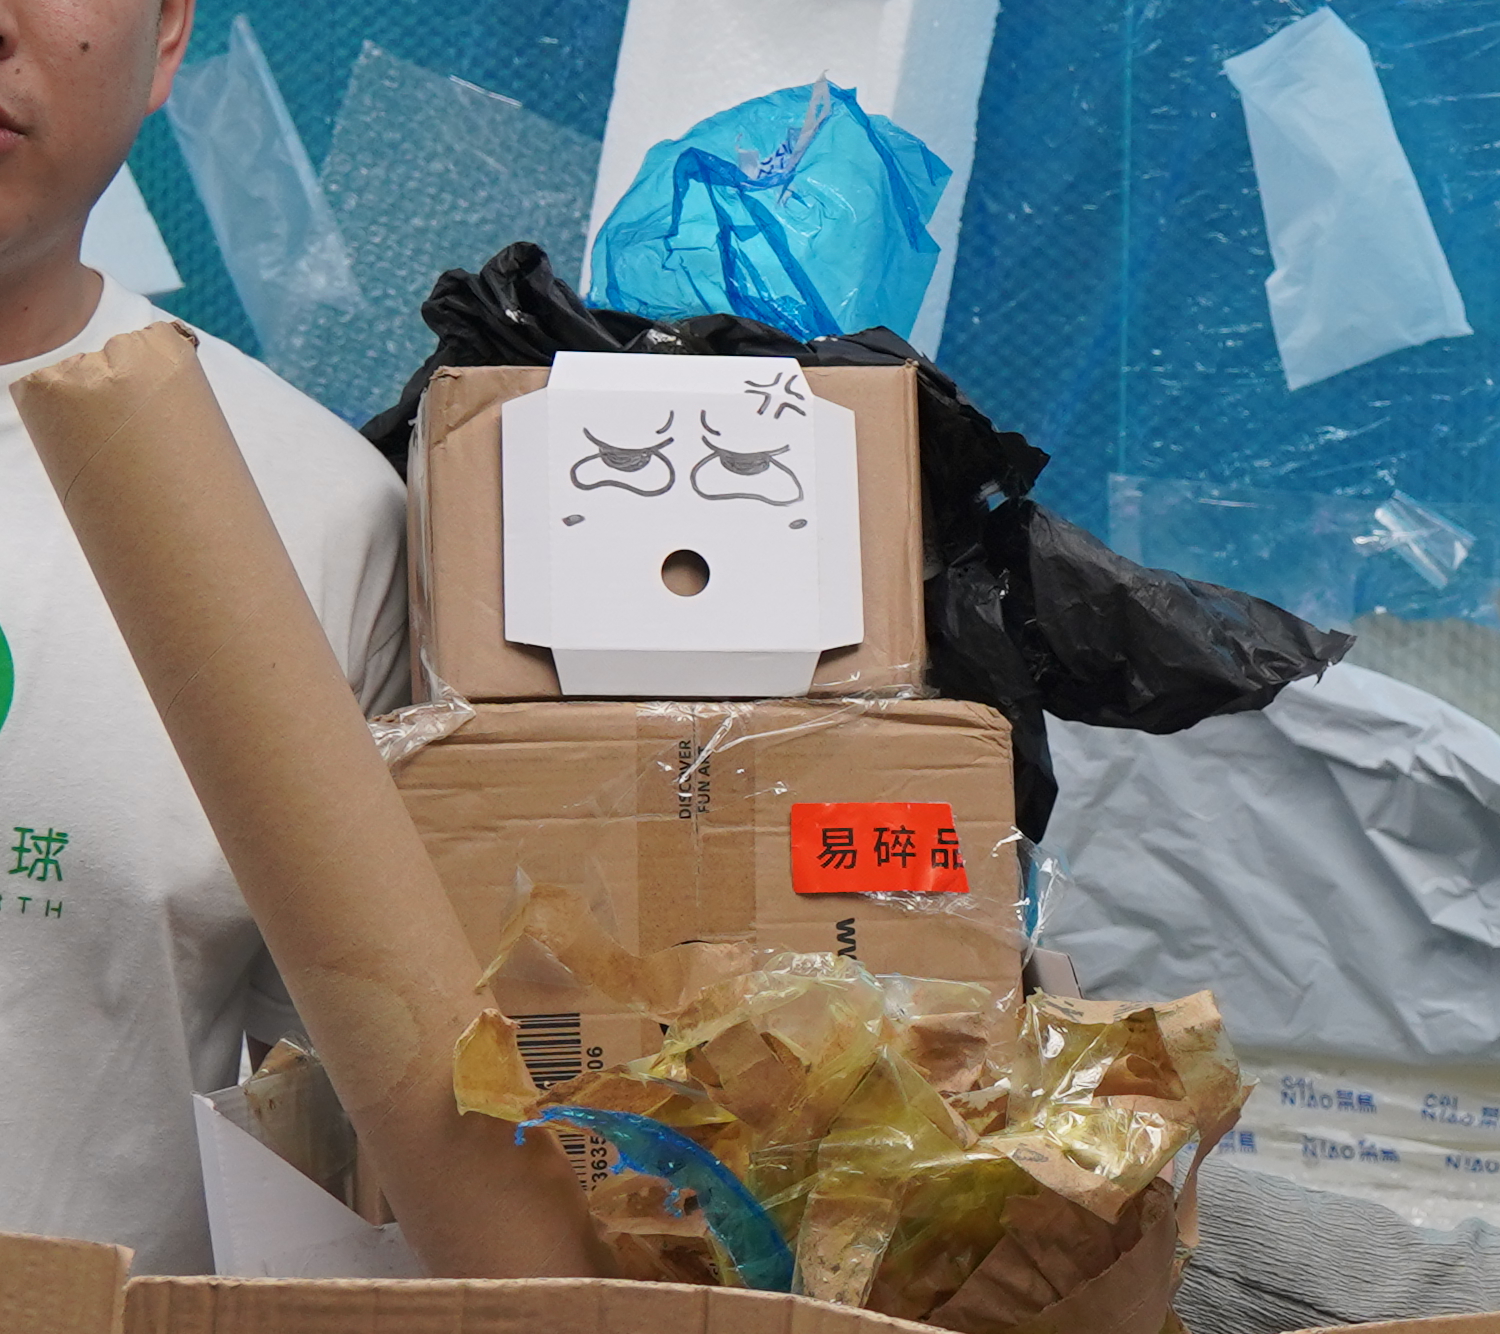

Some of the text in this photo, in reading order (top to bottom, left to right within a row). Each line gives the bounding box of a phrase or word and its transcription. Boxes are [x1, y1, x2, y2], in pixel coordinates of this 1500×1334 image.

[679, 739, 691, 820] DISCOVER
[697, 780, 711, 814] FUN
[816, 824, 966, 871] 易碎品
